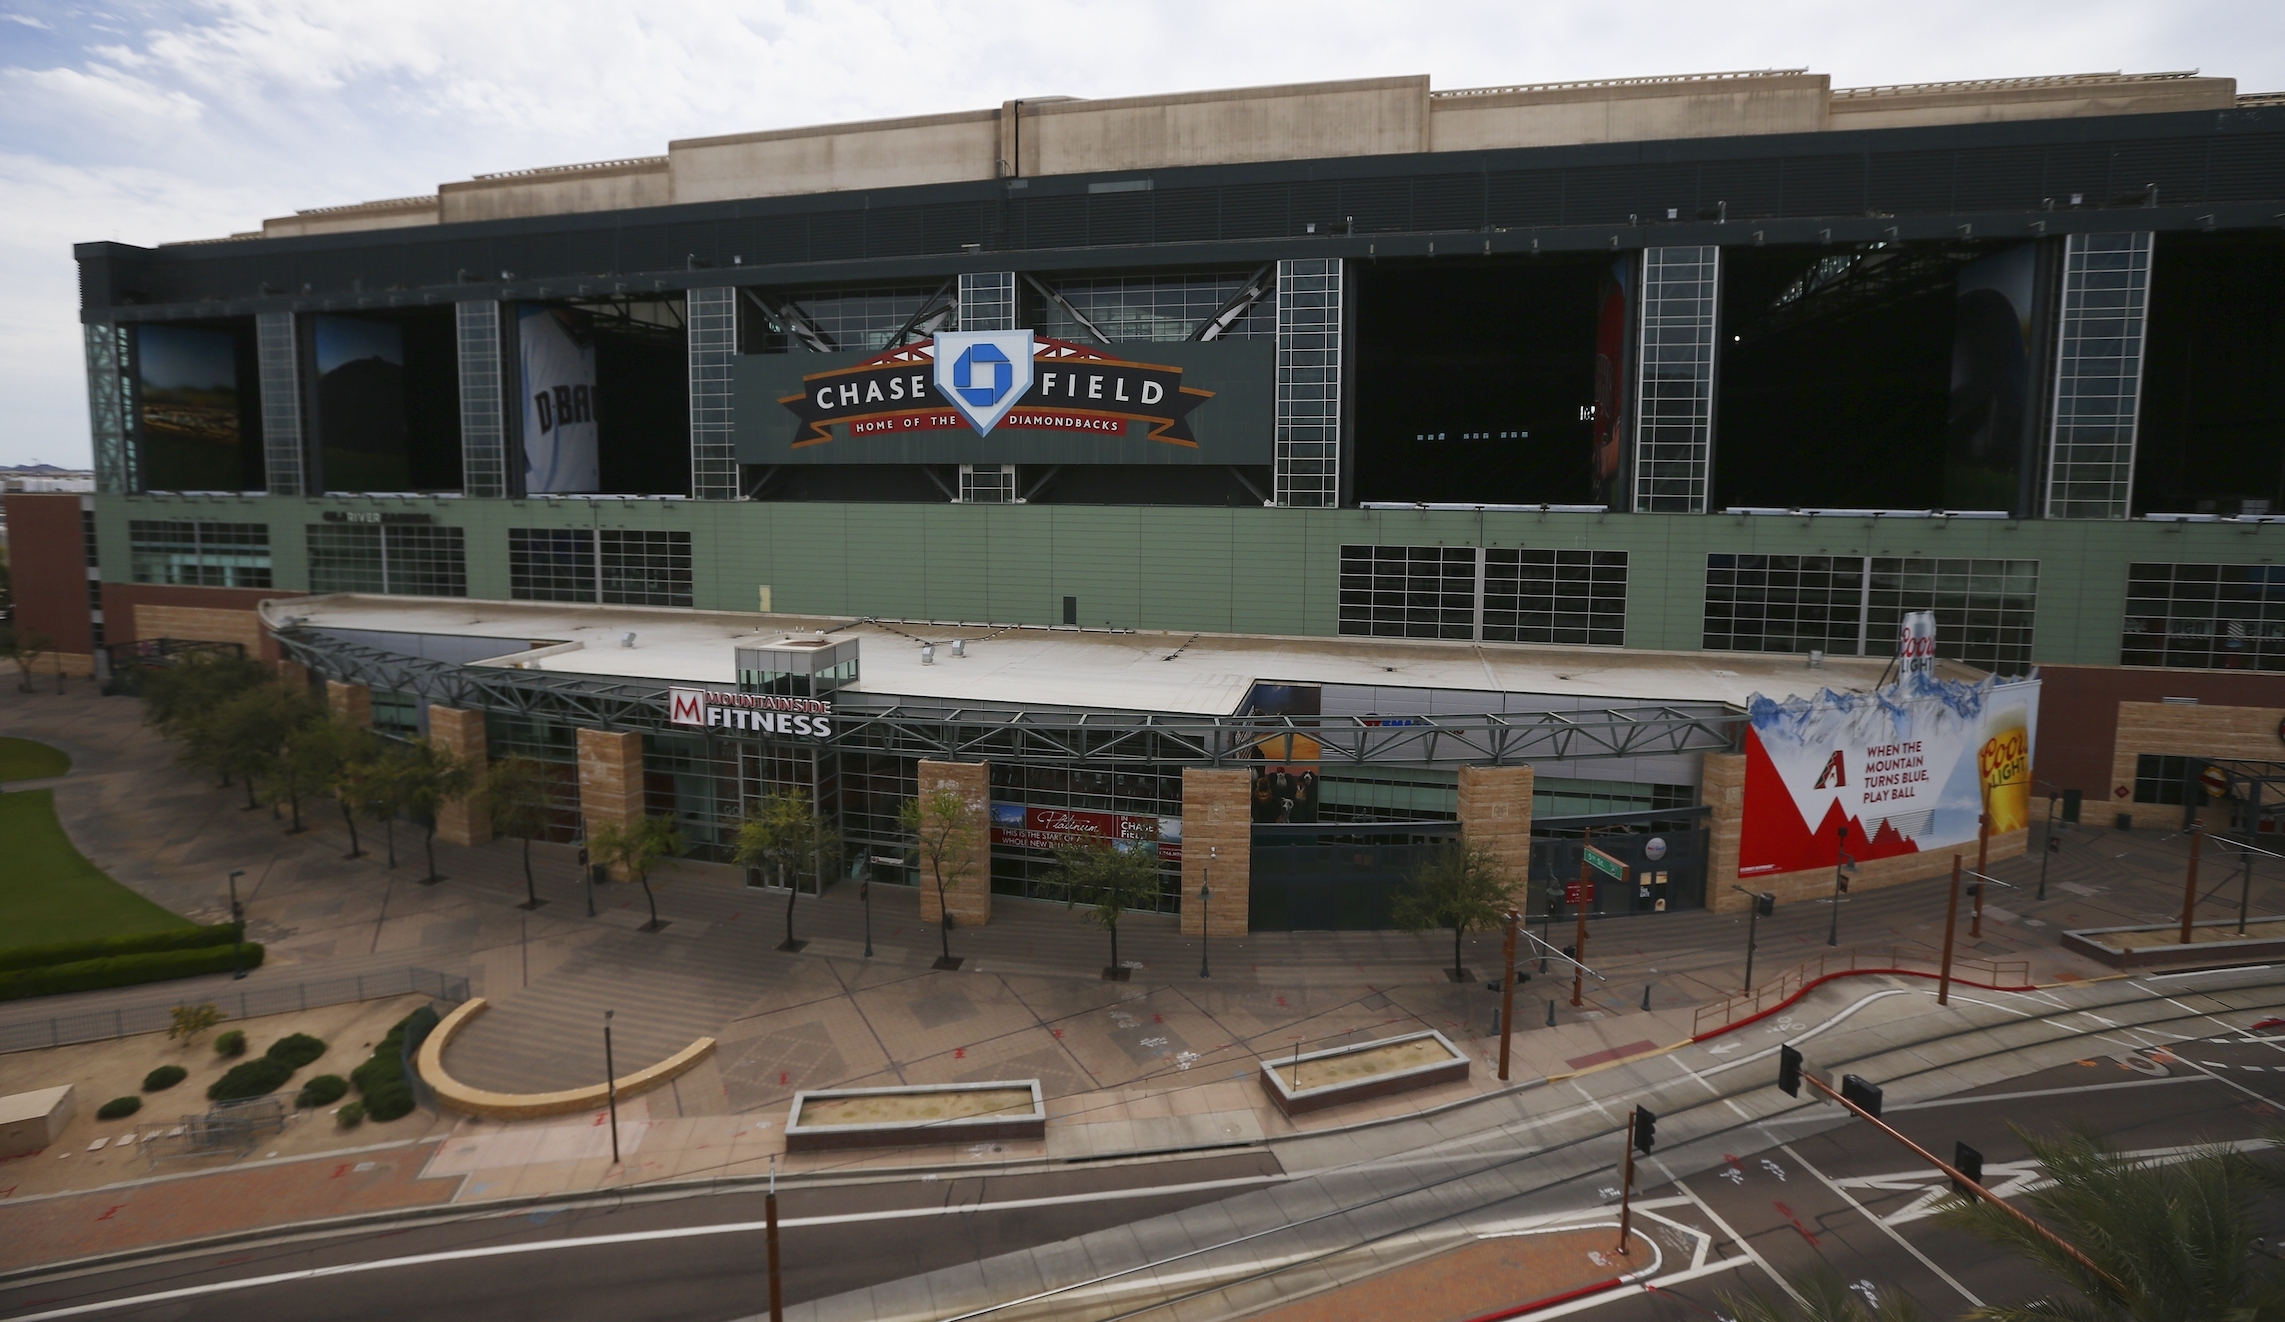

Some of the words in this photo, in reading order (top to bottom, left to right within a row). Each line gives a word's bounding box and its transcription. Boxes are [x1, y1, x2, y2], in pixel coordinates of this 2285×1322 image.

[816, 375, 926, 410] CHASE
[1042, 373, 1165, 405] FIELD
[856, 420, 894, 433] HOME
[903, 418, 921, 428] OF
[930, 415, 956, 427] THE
[1009, 415, 1119, 432] DIAMONDBACKS
[347, 511, 382, 523] RIVER
[1902, 656, 1934, 673] LIGHT
[674, 694, 701, 722] M
[705, 690, 832, 714] MOUNTAINSIDE
[707, 706, 832, 737] FITNESS
[1867, 743, 1899, 758] WHEN
[1902, 741, 1922, 754] THE
[1865, 755, 1923, 773] MOUNTAIN
[1992, 756, 2025, 787] LIGHT
[1865, 773, 1899, 788] TURNS
[1902, 769, 1929, 783] BLUE,
[1863, 789, 1889, 804] PLAY
[1892, 786, 1915, 800] BALL
[1037, 811, 1099, 832] Platinum
[1002, 829, 1018, 837] THIS
[1019, 830, 1026, 838] IS
[1030, 840, 1047, 848] NEW
